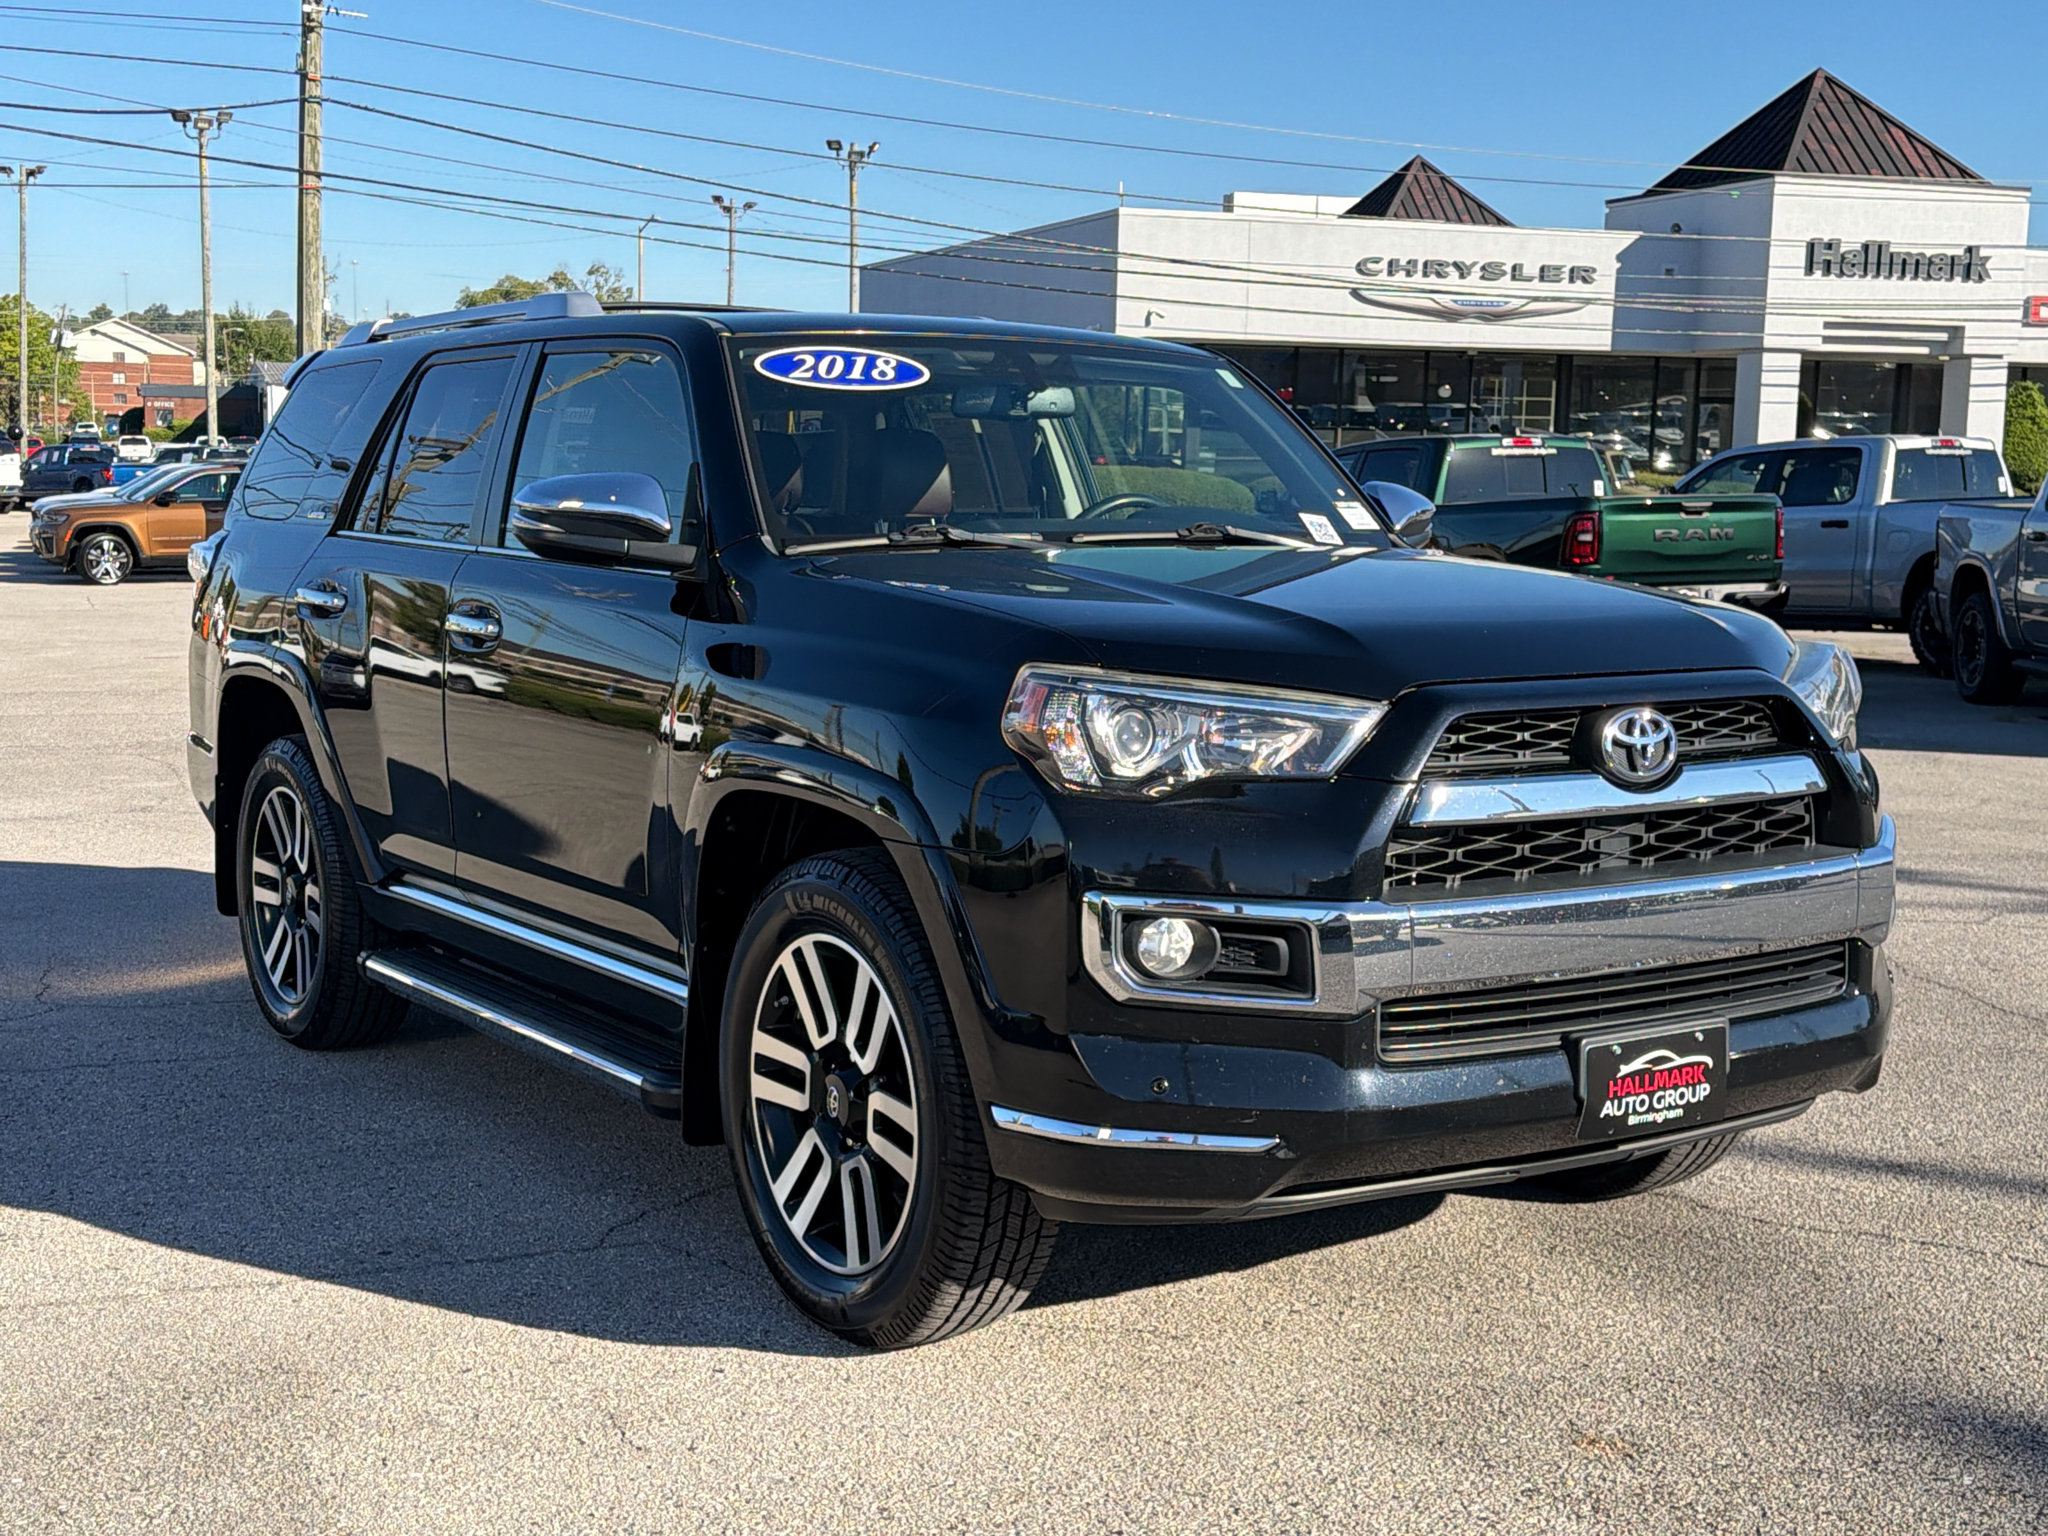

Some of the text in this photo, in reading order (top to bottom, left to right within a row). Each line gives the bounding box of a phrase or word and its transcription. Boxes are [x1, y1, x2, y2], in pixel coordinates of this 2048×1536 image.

[1355, 256, 1597, 285] CHRYSLER
[1804, 237, 1992, 284] Hallmark
[788, 354, 897, 381] 2018
[1654, 527, 1735, 541] RAM
[812, 893, 875, 949] MICHELIN
[1608, 1064, 1706, 1098] HALLMARK
[1600, 1083, 1711, 1118] AUTO GROUP
[1627, 1107, 1684, 1126] Birmingham
